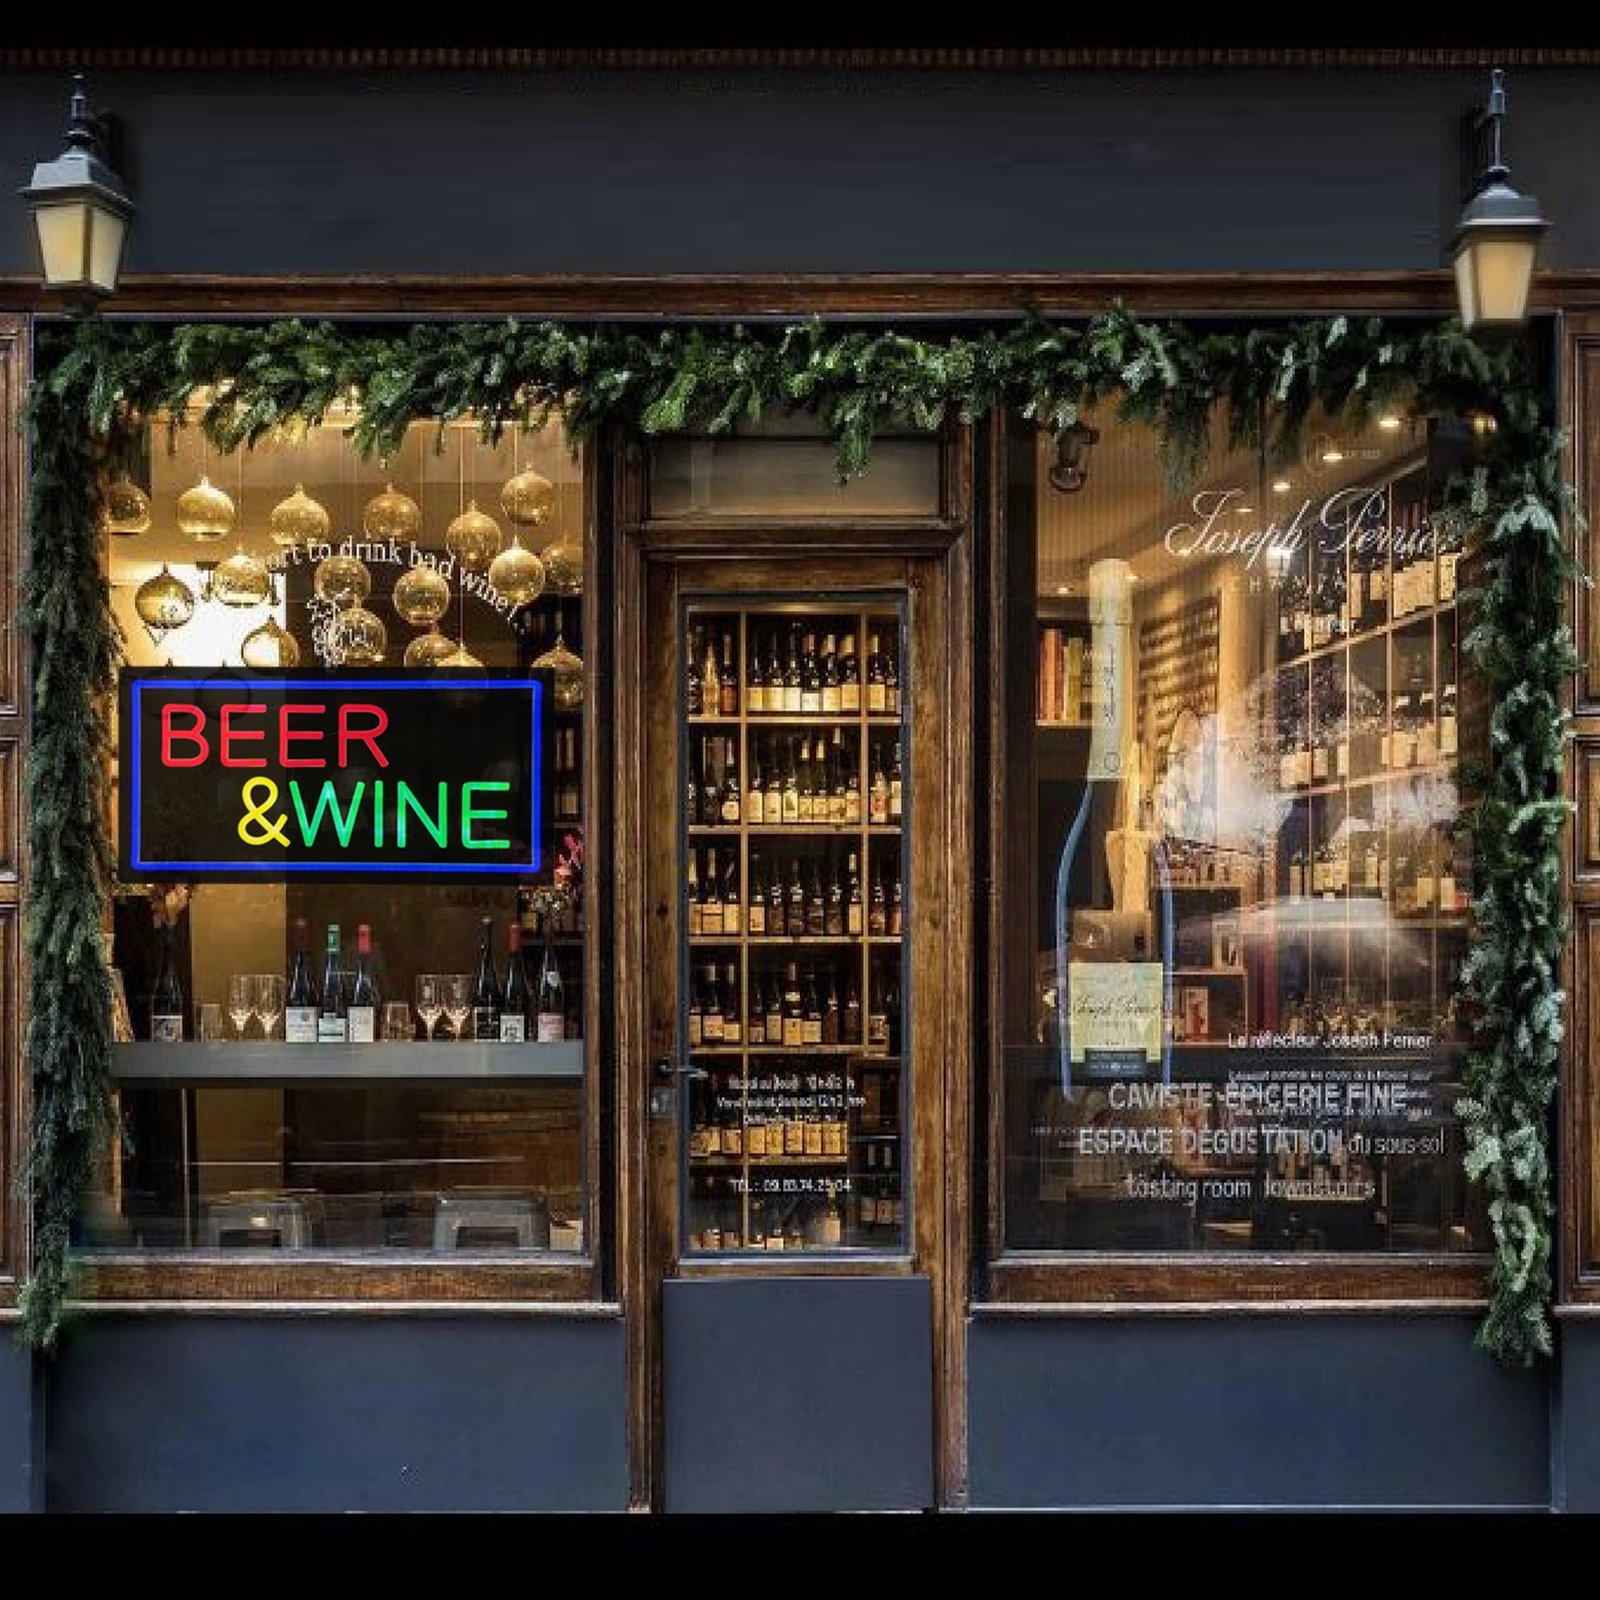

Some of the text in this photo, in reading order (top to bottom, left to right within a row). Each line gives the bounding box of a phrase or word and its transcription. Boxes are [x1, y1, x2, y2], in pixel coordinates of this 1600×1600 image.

[308, 540, 332, 560] to
[339, 534, 403, 565] drink
[409, 540, 456, 580] bad
[161, 703, 389, 768] BEER
[1349, 1082, 1407, 1110] FINE
[1079, 1127, 1173, 1155] ESPACE
[1125, 1171, 1197, 1209] tasting
[1203, 1180, 1251, 1199] room
